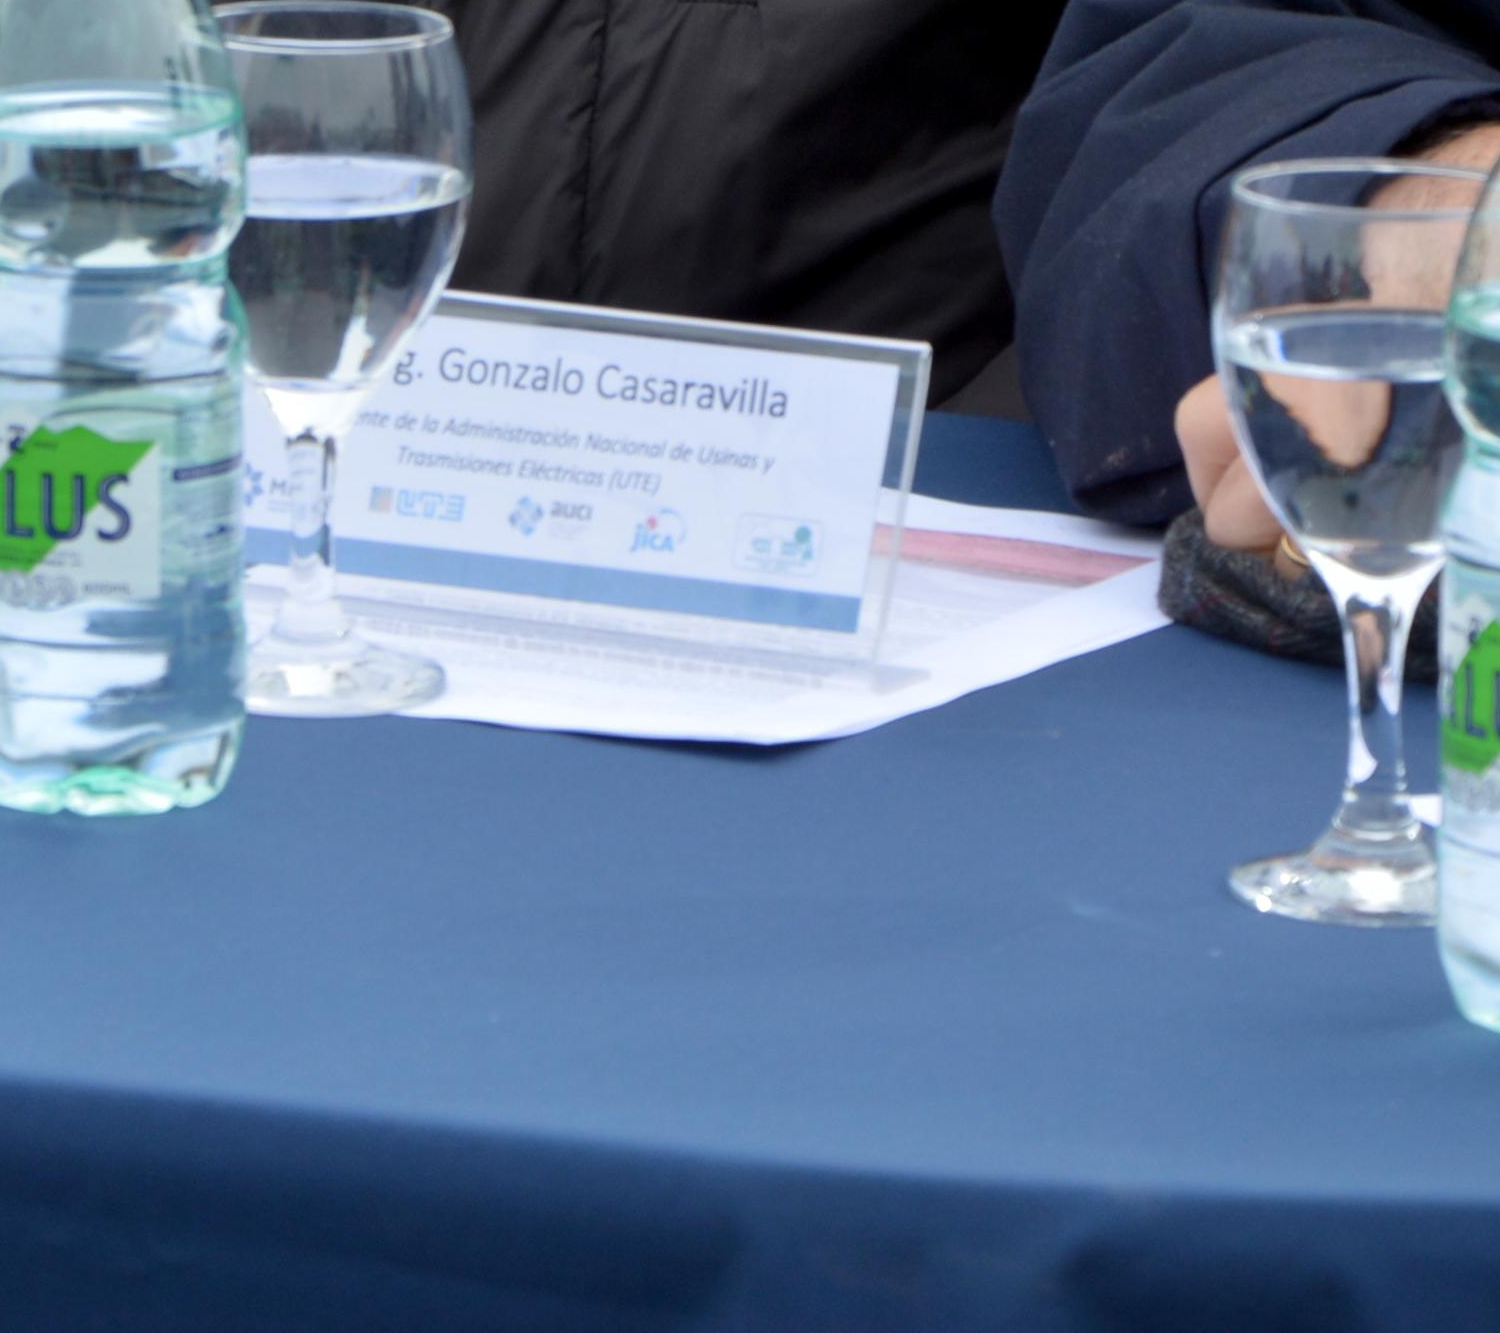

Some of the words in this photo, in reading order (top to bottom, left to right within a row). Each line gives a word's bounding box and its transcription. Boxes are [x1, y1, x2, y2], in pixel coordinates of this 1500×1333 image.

[393, 351, 424, 385] g.
[438, 348, 584, 396] Gonzalo
[596, 364, 789, 418] Casaravilla
[354, 410, 391, 429] nte
[394, 411, 418, 432] de
[422, 414, 442, 434] la
[443, 418, 580, 449] Administración
[584, 434, 666, 458] Nacional
[669, 443, 693, 461] de
[697, 446, 758, 470] Usinas
[762, 457, 775, 474] y
[398, 445, 513, 476] Trasmisiones
[518, 459, 604, 486] Eléctricas
[608, 469, 662, 496] (UTE)
